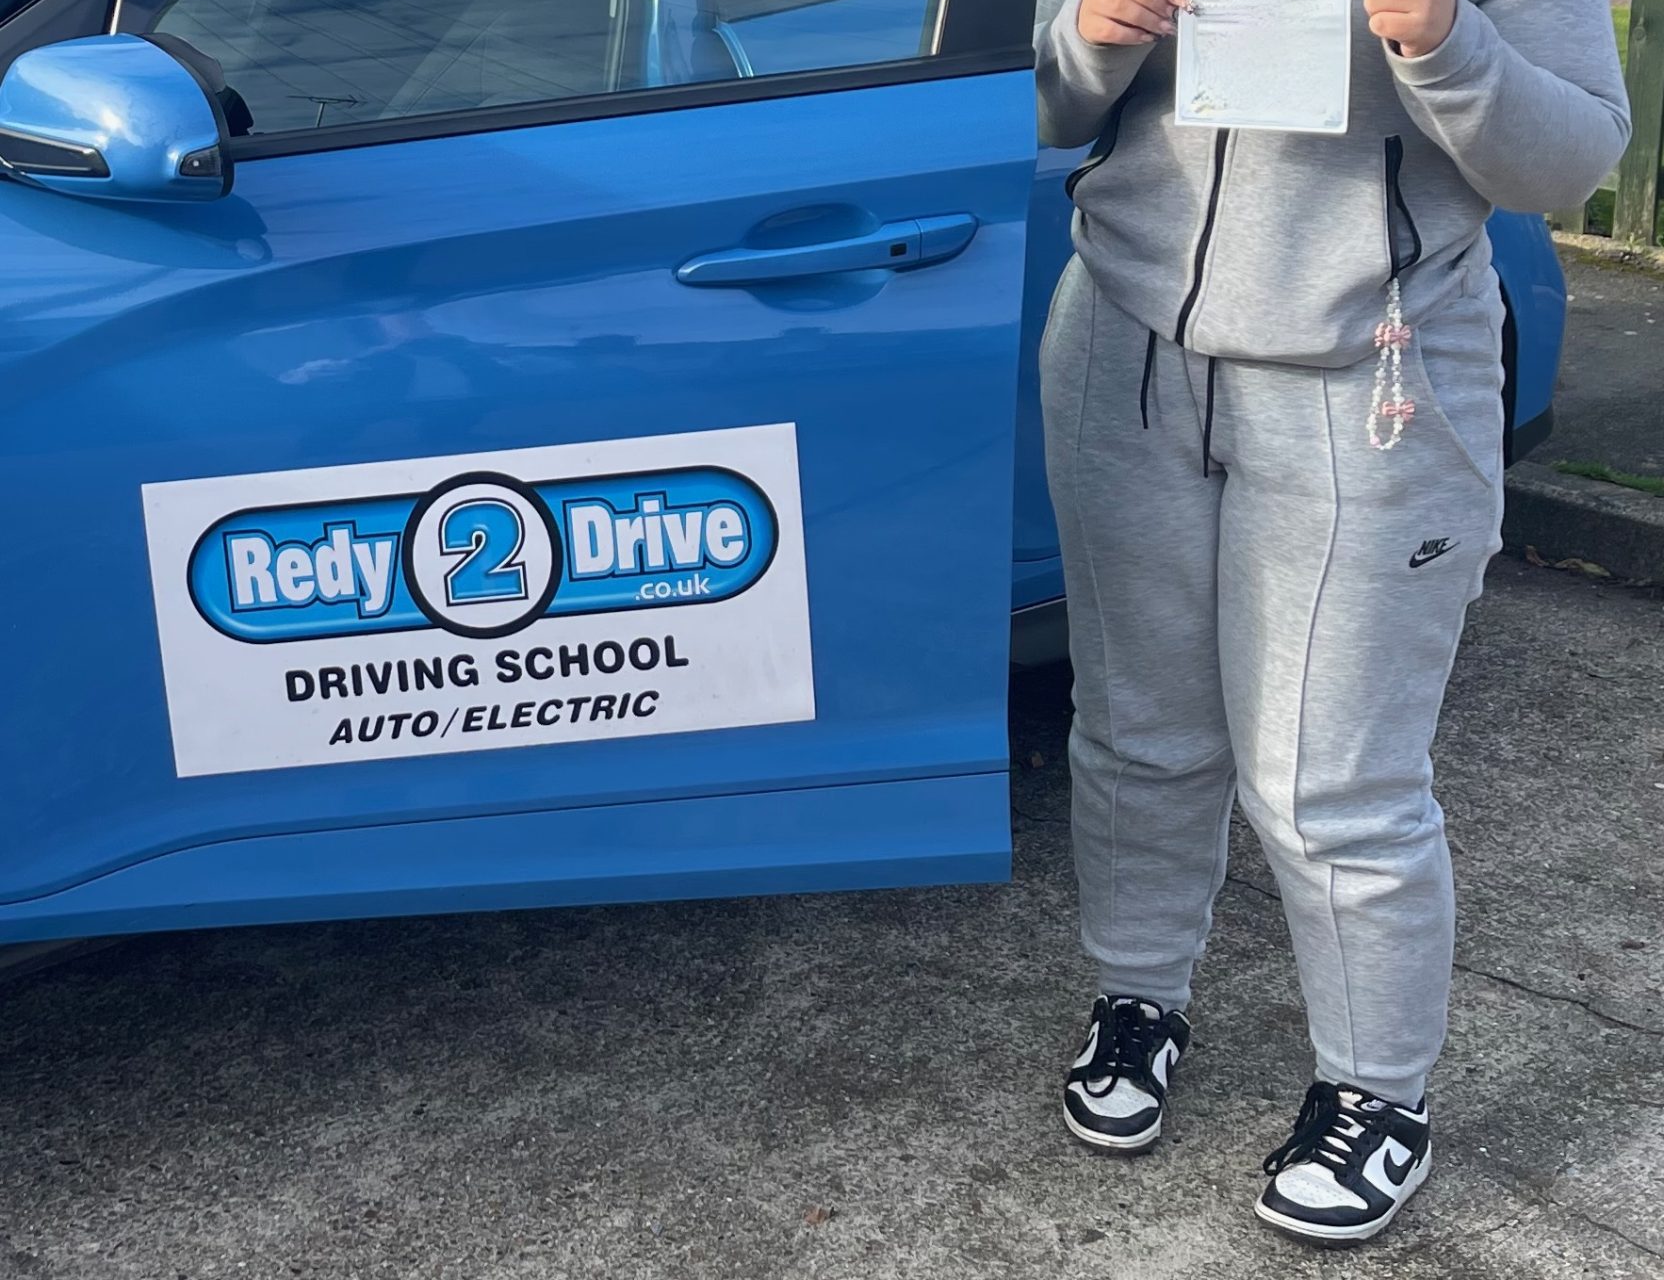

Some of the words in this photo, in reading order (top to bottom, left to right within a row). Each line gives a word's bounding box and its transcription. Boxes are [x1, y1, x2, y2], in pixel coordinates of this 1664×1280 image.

[228, 525, 395, 615] Redy
[439, 498, 528, 606] 2
[568, 497, 747, 576] Drive
[635, 573, 712, 601] .co.uk
[285, 653, 480, 702] DRIVING
[495, 634, 690, 684] SCHOOL
[328, 689, 660, 746] AUTO/ELECTRIC
